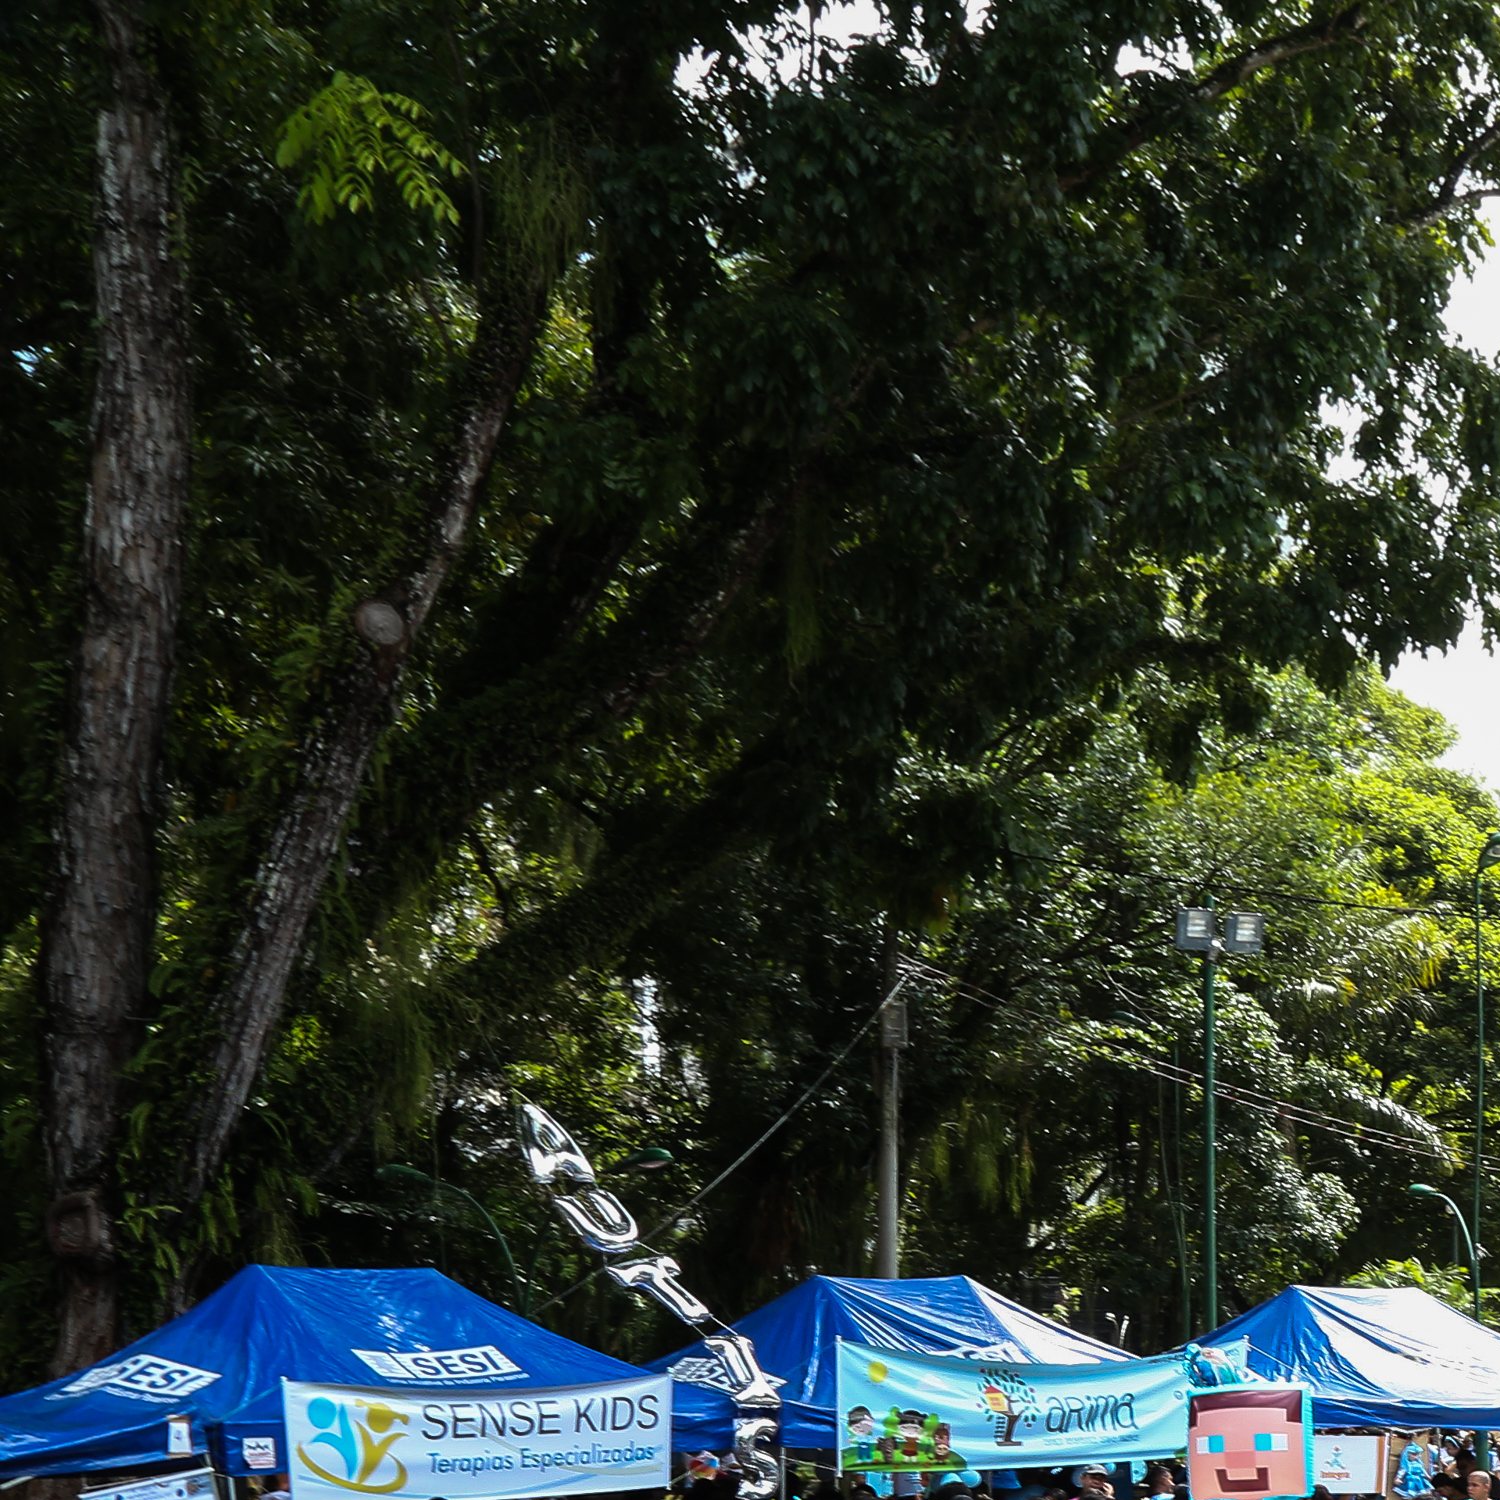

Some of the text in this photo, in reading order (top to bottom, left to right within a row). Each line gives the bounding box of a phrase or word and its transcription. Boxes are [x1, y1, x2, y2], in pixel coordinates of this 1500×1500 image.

[410, 1350, 502, 1377] SESI
[420, 1395, 659, 1440] SENSE KIDS
[427, 1440, 655, 1477] Terapias Especializadas
